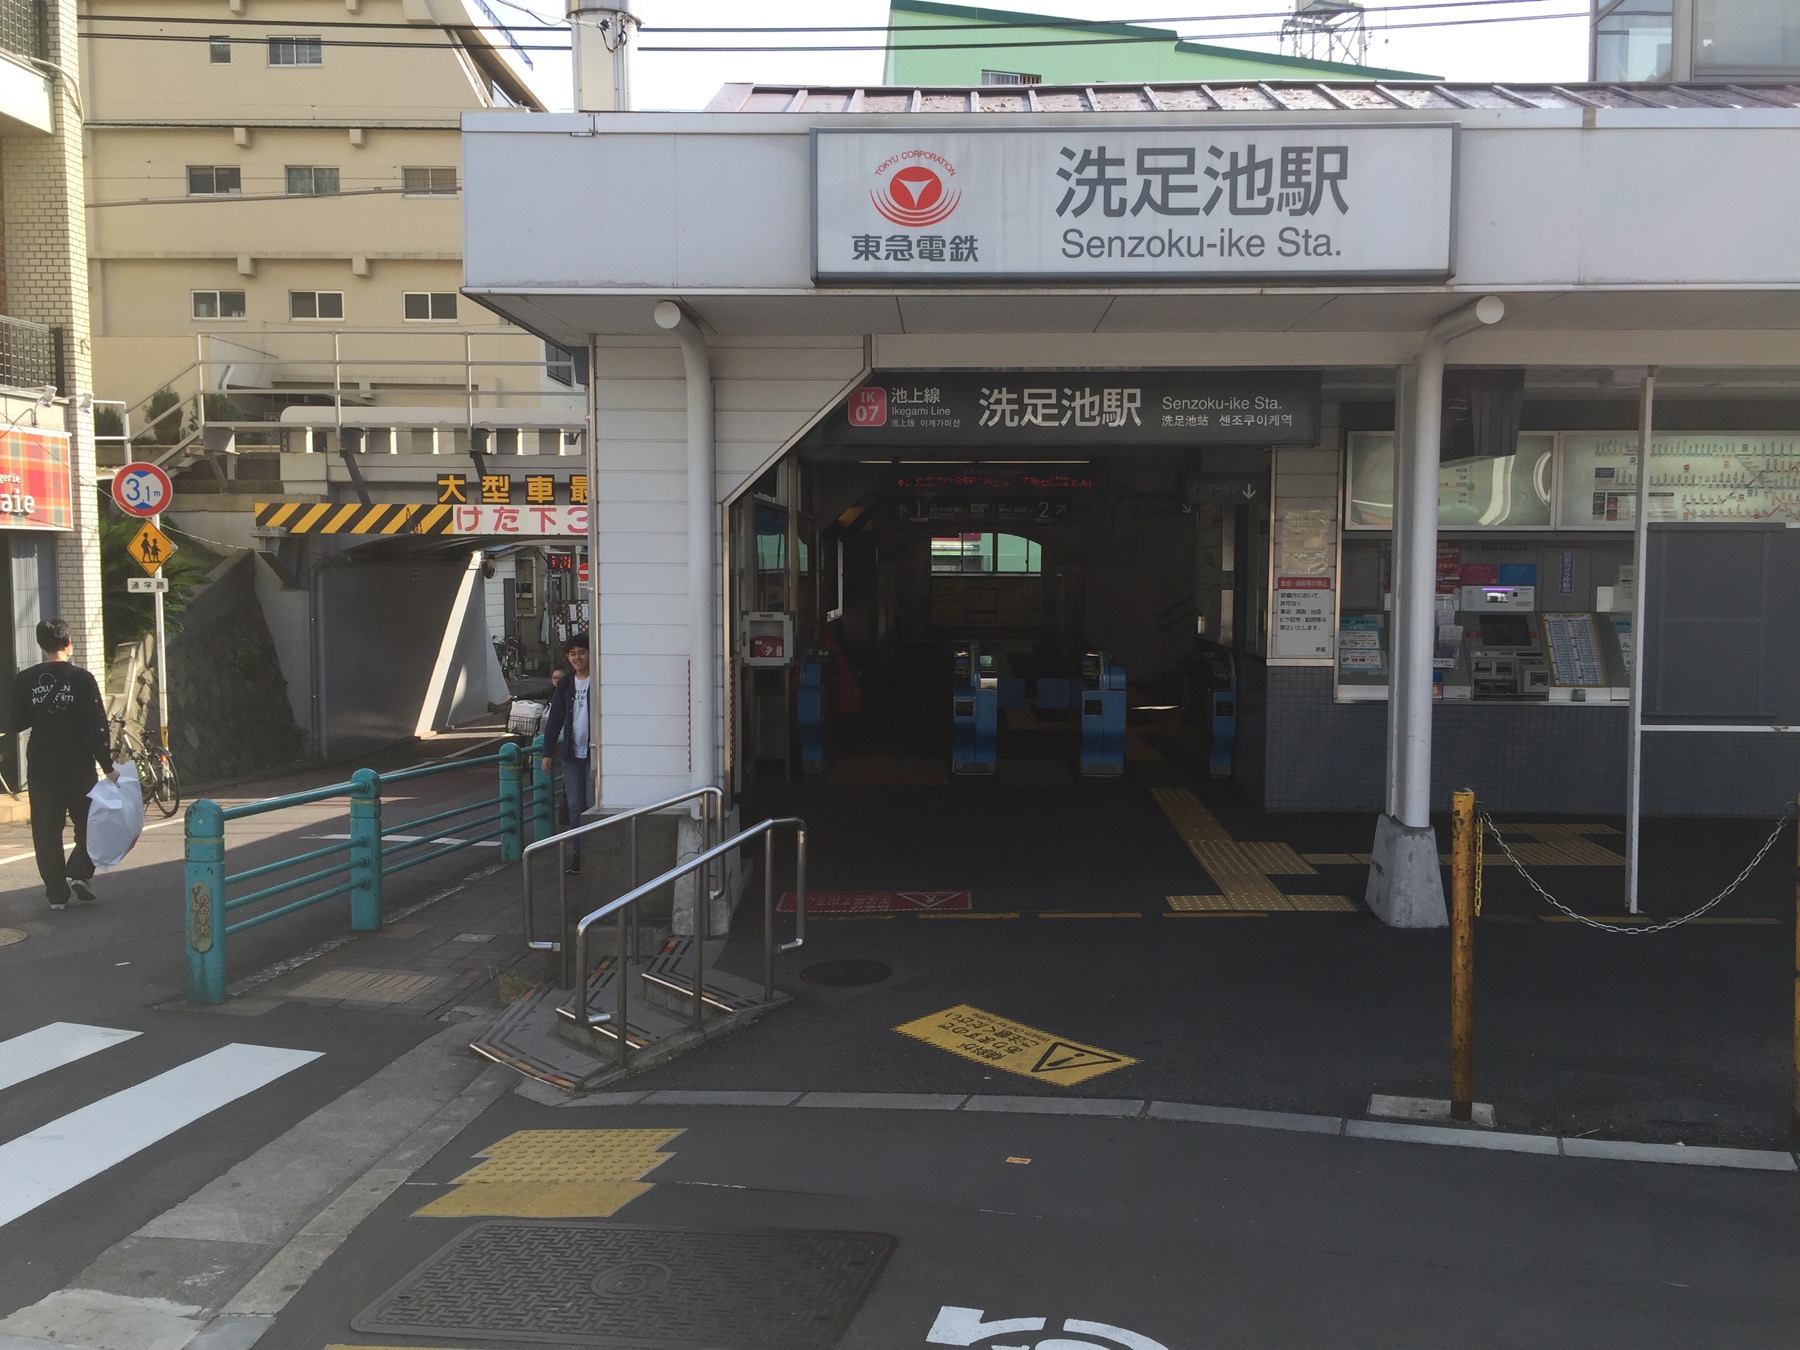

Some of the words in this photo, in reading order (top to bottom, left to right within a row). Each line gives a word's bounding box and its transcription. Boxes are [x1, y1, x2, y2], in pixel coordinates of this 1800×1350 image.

[874, 155, 899, 177] TOKYU
[901, 149, 957, 177] CORPORATION
[1055, 144, 1349, 217] 洗足池駅
[851, 234, 979, 263] 東急電鉄
[1061, 228, 1266, 260] Senzoku-ike
[1276, 227, 1343, 258] Sta.
[860, 391, 876, 403] IK
[891, 387, 941, 404] 池上線
[1162, 396, 1250, 411] Senzoku-ike
[1254, 396, 1282, 411] Sta.
[855, 405, 880, 422] 07
[891, 406, 929, 418] Ikegami
[930, 406, 951, 417] Line
[978, 387, 1142, 428] 洗足池駅
[1161, 414, 1209, 427] 洗足池站
[1218, 413, 1292, 427] 센조쿠이케역
[438, 474, 588, 504] 大型車最
[1038, 500, 1050, 518] 2
[131, 581, 165, 590] 通学路
